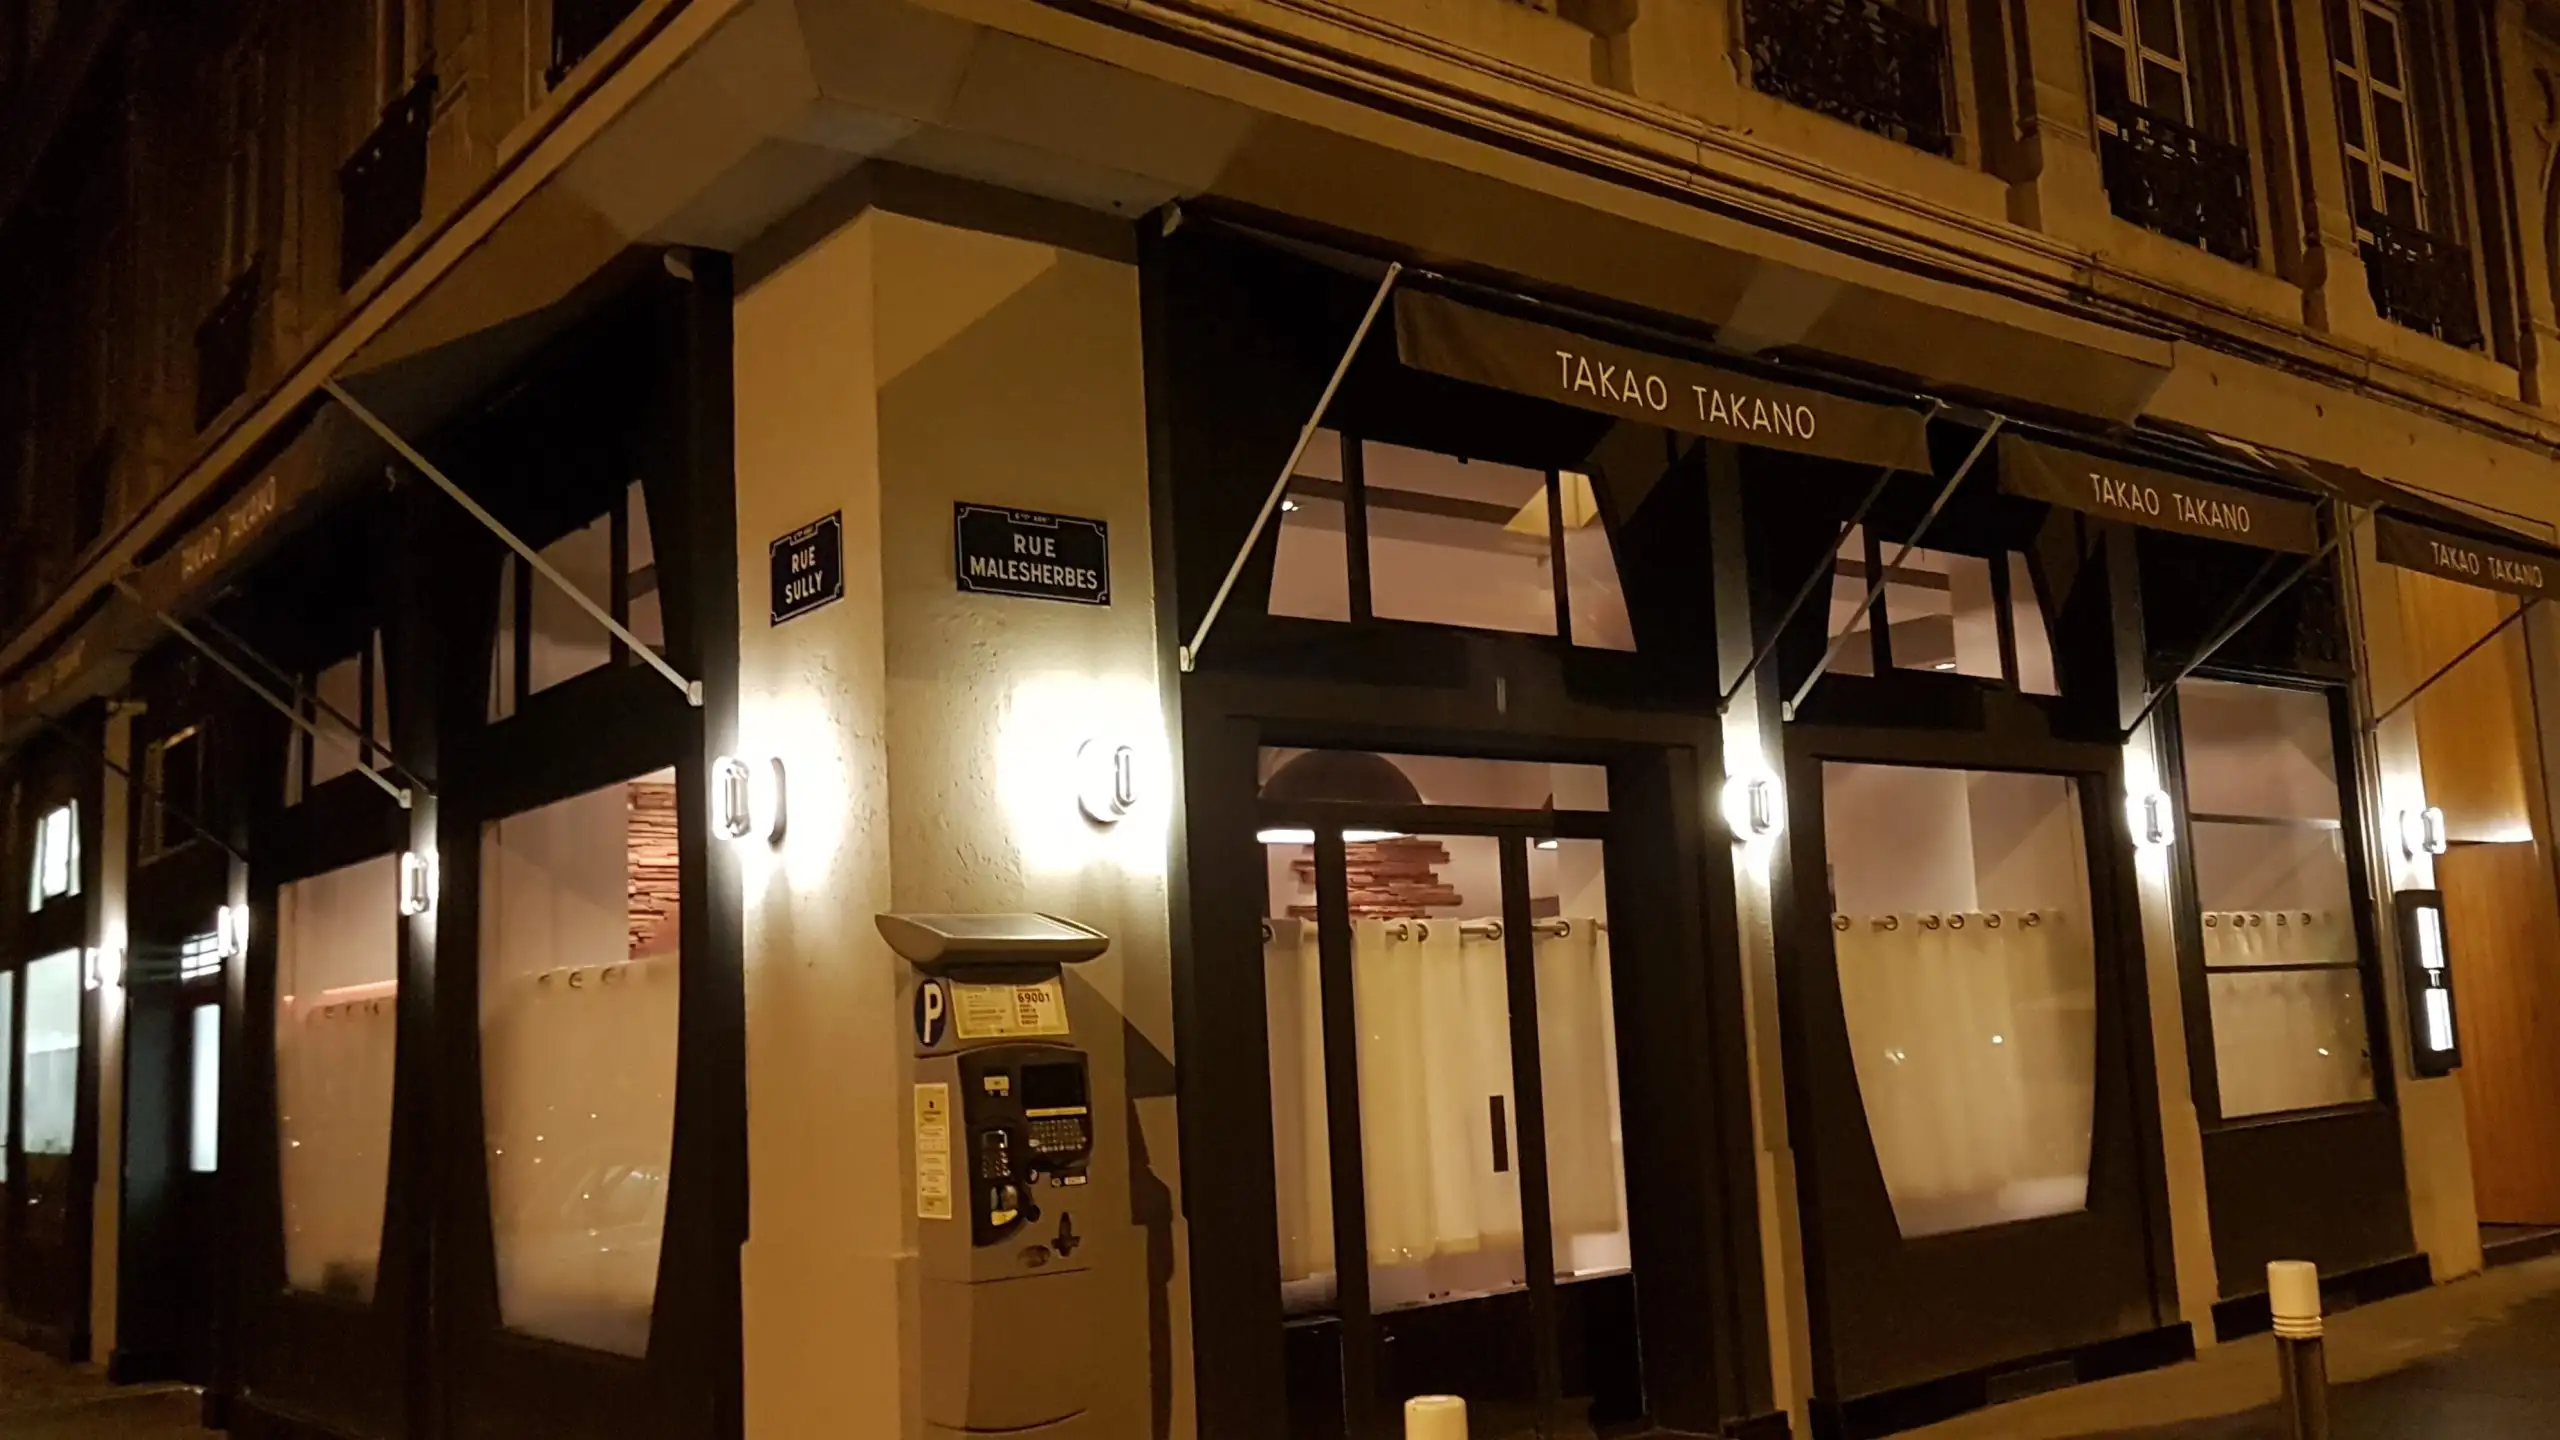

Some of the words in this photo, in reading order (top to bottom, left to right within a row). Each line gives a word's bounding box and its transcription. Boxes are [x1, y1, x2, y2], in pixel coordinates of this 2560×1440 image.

[1556, 350, 1668, 411] TAKAO
[1692, 385, 1816, 440] TAKANO
[2088, 473, 2160, 516] TAKAO
[2172, 493, 2251, 533] TAKANO
[791, 545, 816, 574] RUE
[1013, 533, 1057, 558] RUE
[970, 555, 1098, 590] MALESHERBES
[2430, 541, 2480, 576] TAKAO
[2487, 556, 2544, 589] TAKANO
[784, 570, 823, 605] SULLY
[923, 982, 943, 1044] P
[1017, 992, 1051, 1003] 69001
